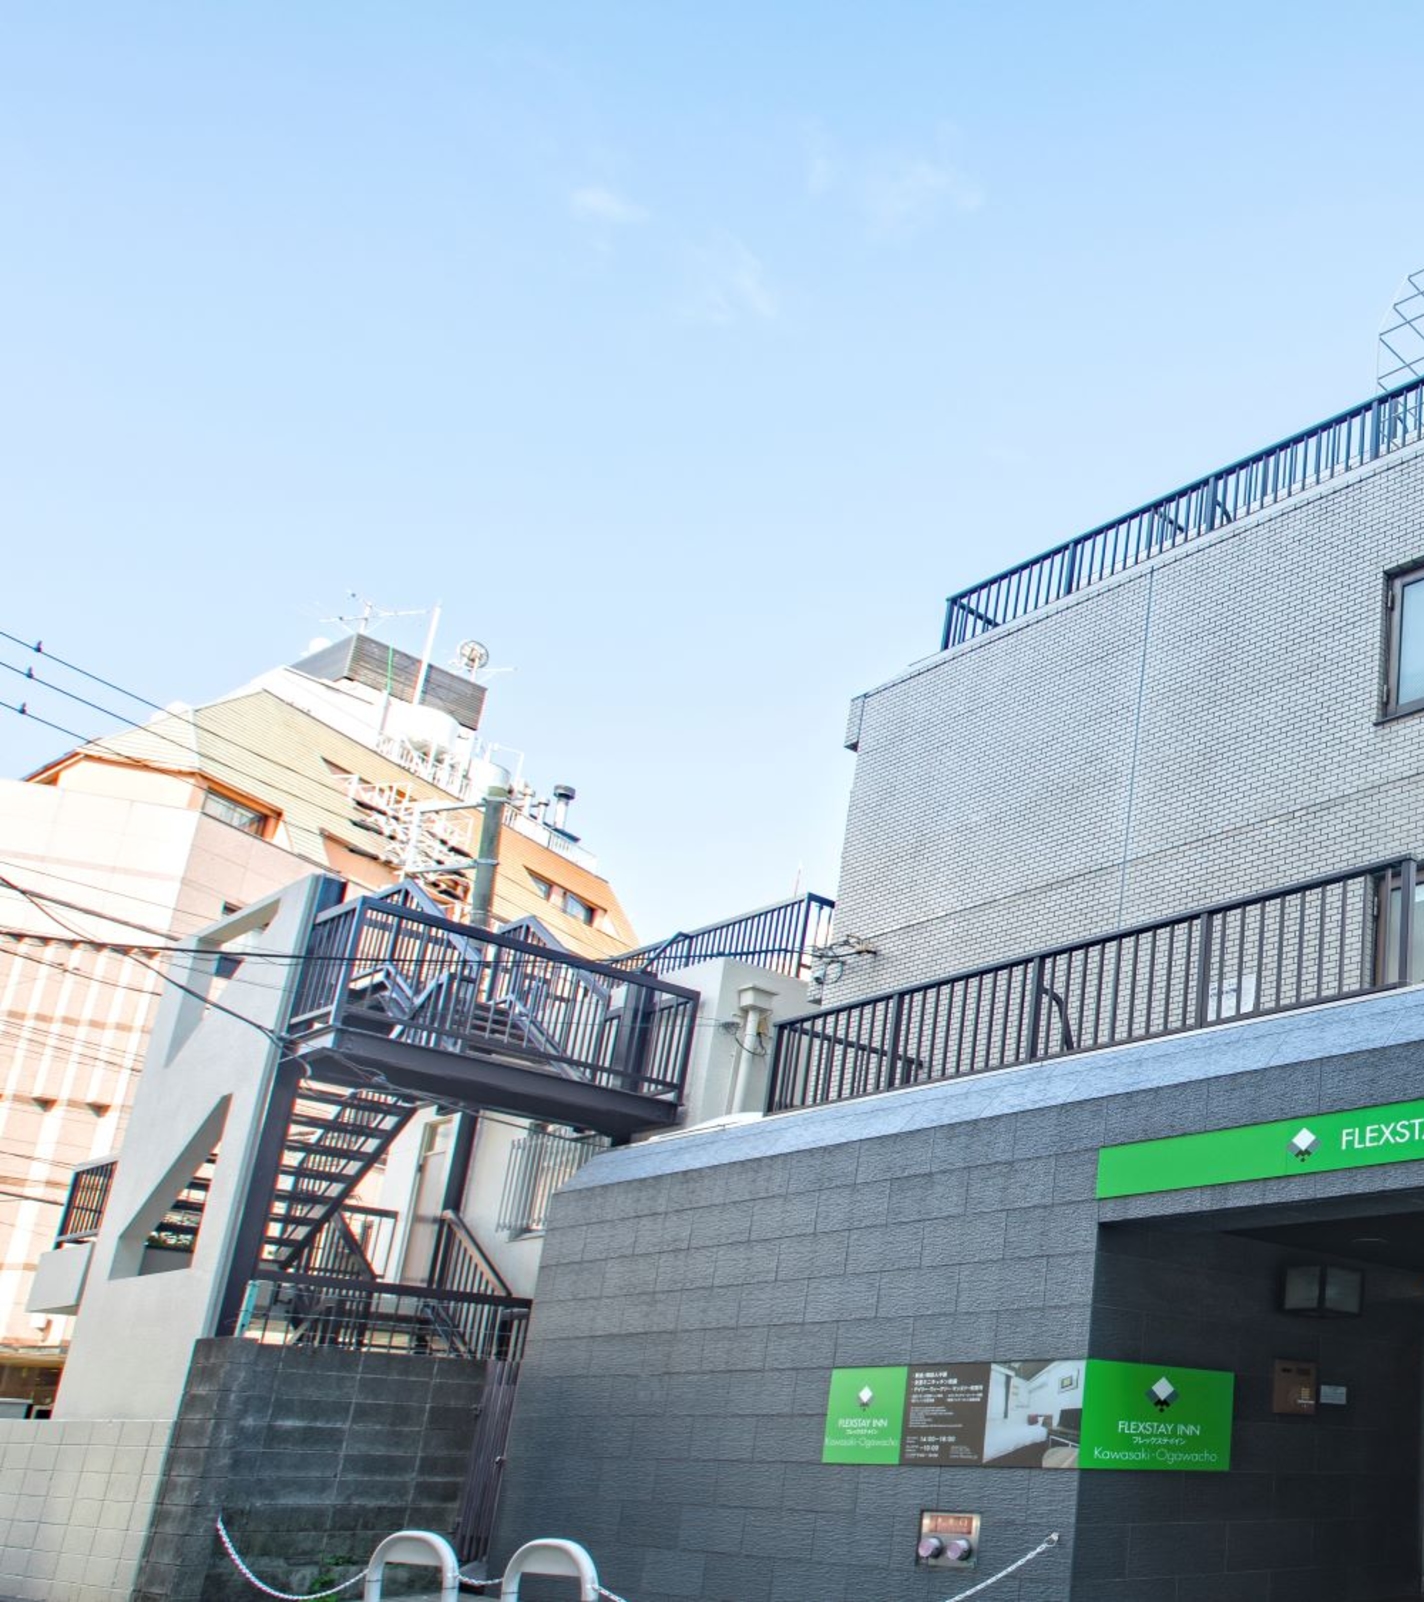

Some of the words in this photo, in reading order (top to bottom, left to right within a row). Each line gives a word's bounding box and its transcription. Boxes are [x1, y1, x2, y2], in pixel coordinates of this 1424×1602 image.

[838, 1418, 870, 1429] FLEXSTAY
[872, 1417, 889, 1428] INN
[1118, 1420, 1174, 1435] FLEXSTAY
[1177, 1423, 1200, 1436] INN
